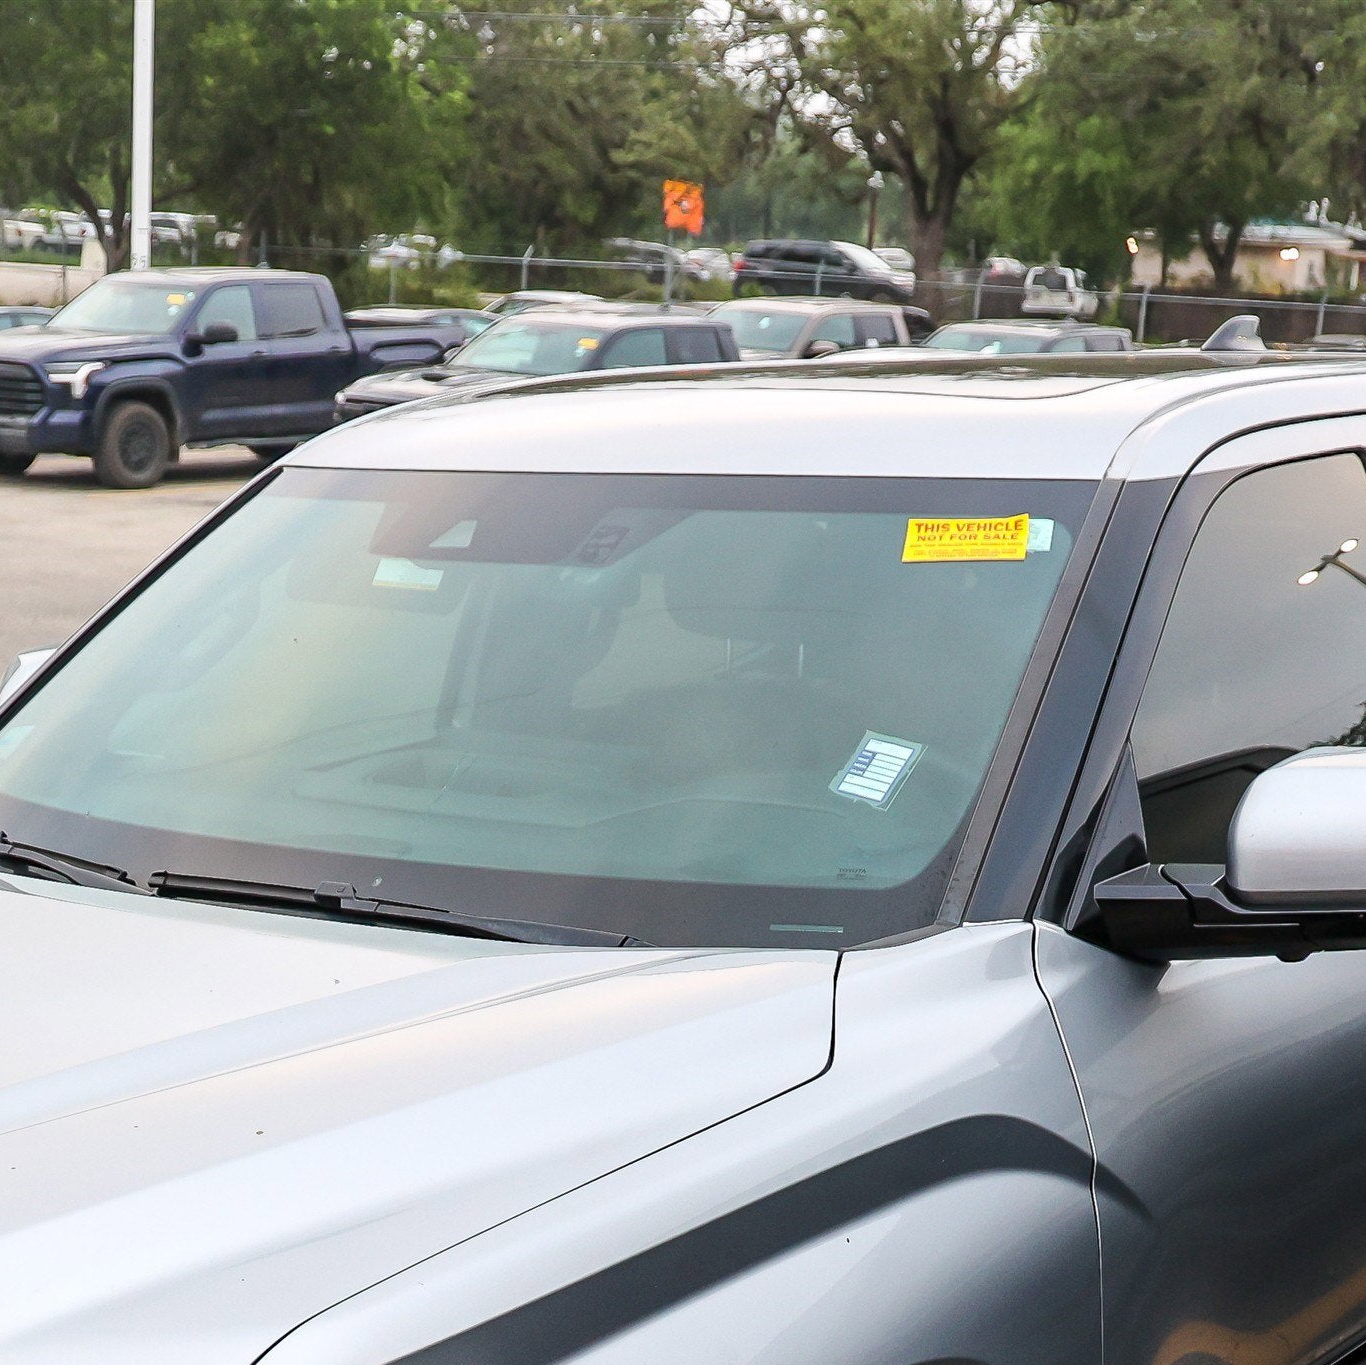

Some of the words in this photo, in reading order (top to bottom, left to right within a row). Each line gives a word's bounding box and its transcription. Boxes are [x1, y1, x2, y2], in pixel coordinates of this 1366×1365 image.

[915, 522, 951, 534] THIS
[956, 519, 1024, 532] VEHICLE
[917, 534, 945, 542] NOT
[949, 533, 978, 541] FOR
[983, 532, 1019, 541] SALE
